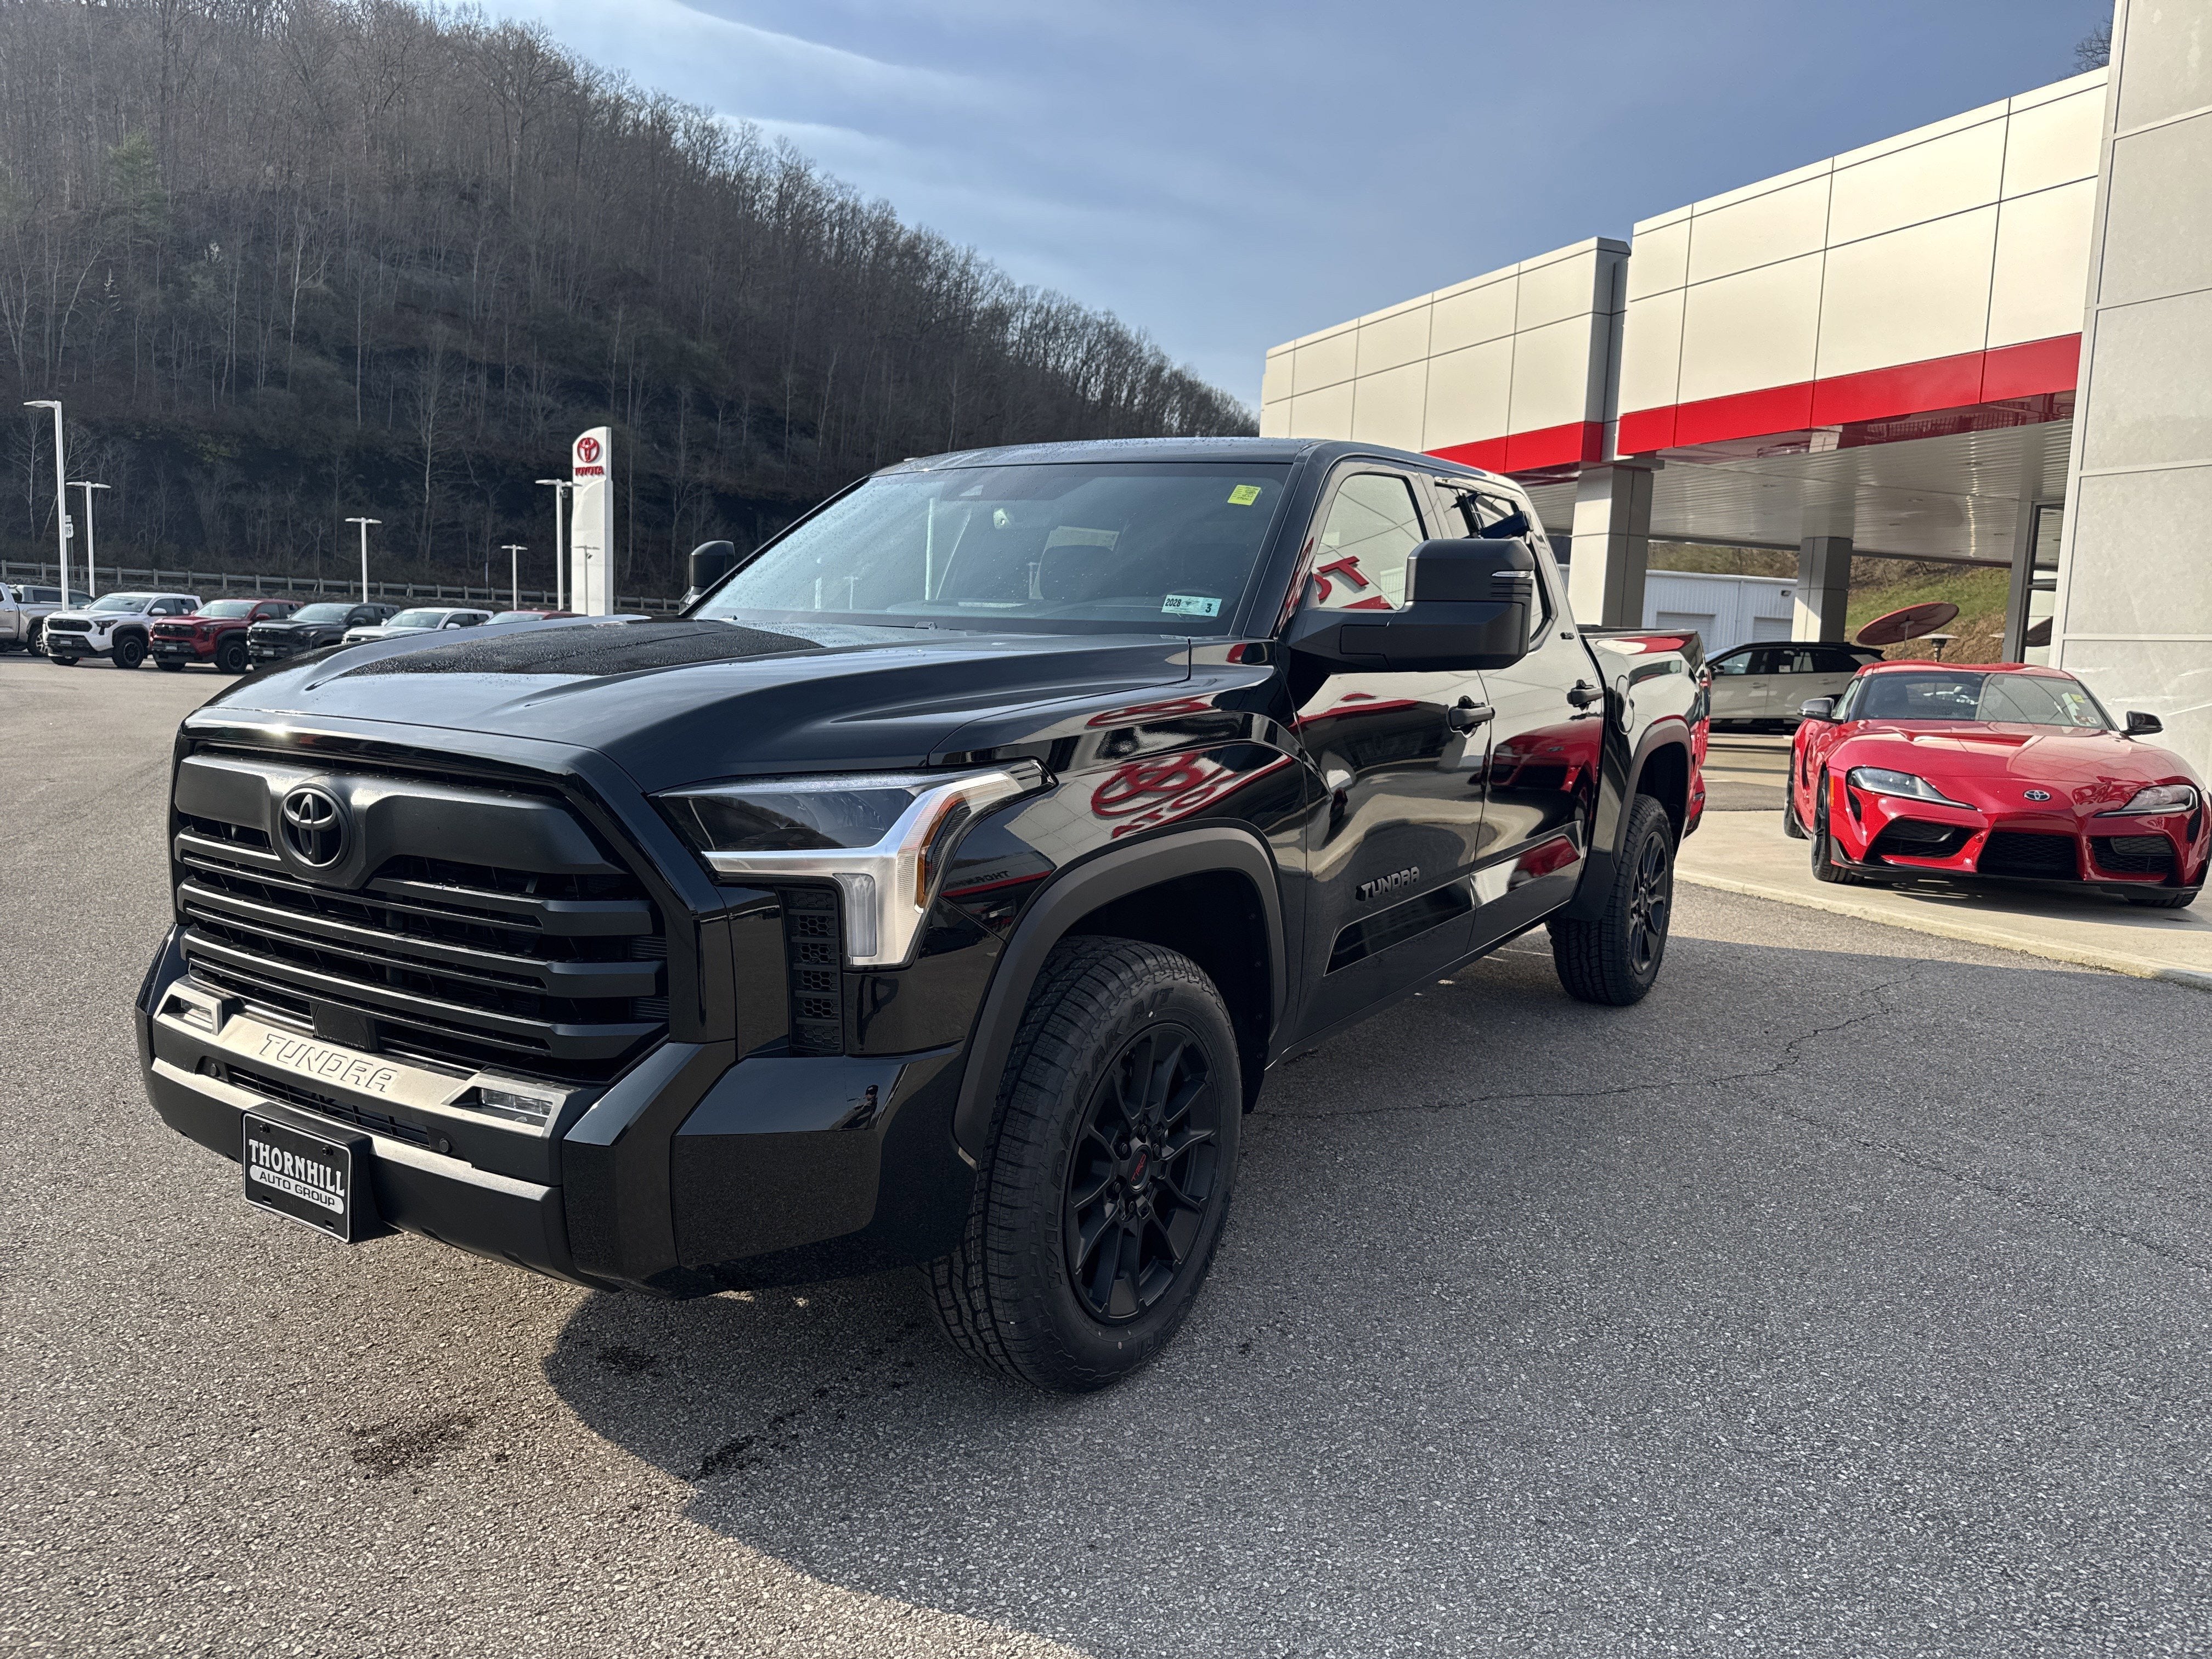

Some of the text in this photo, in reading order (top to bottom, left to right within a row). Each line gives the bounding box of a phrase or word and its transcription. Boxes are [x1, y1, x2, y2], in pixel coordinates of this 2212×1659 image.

[1165, 598, 1212, 613] 2028 3
[1356, 866, 1420, 900] TUNDRA
[259, 1034, 397, 1092] TUNDRA
[249, 1139, 345, 1197] THORNHILL
[1131, 1153, 1146, 1182] TRD
[259, 1171, 335, 1206] AUTO GROUP
